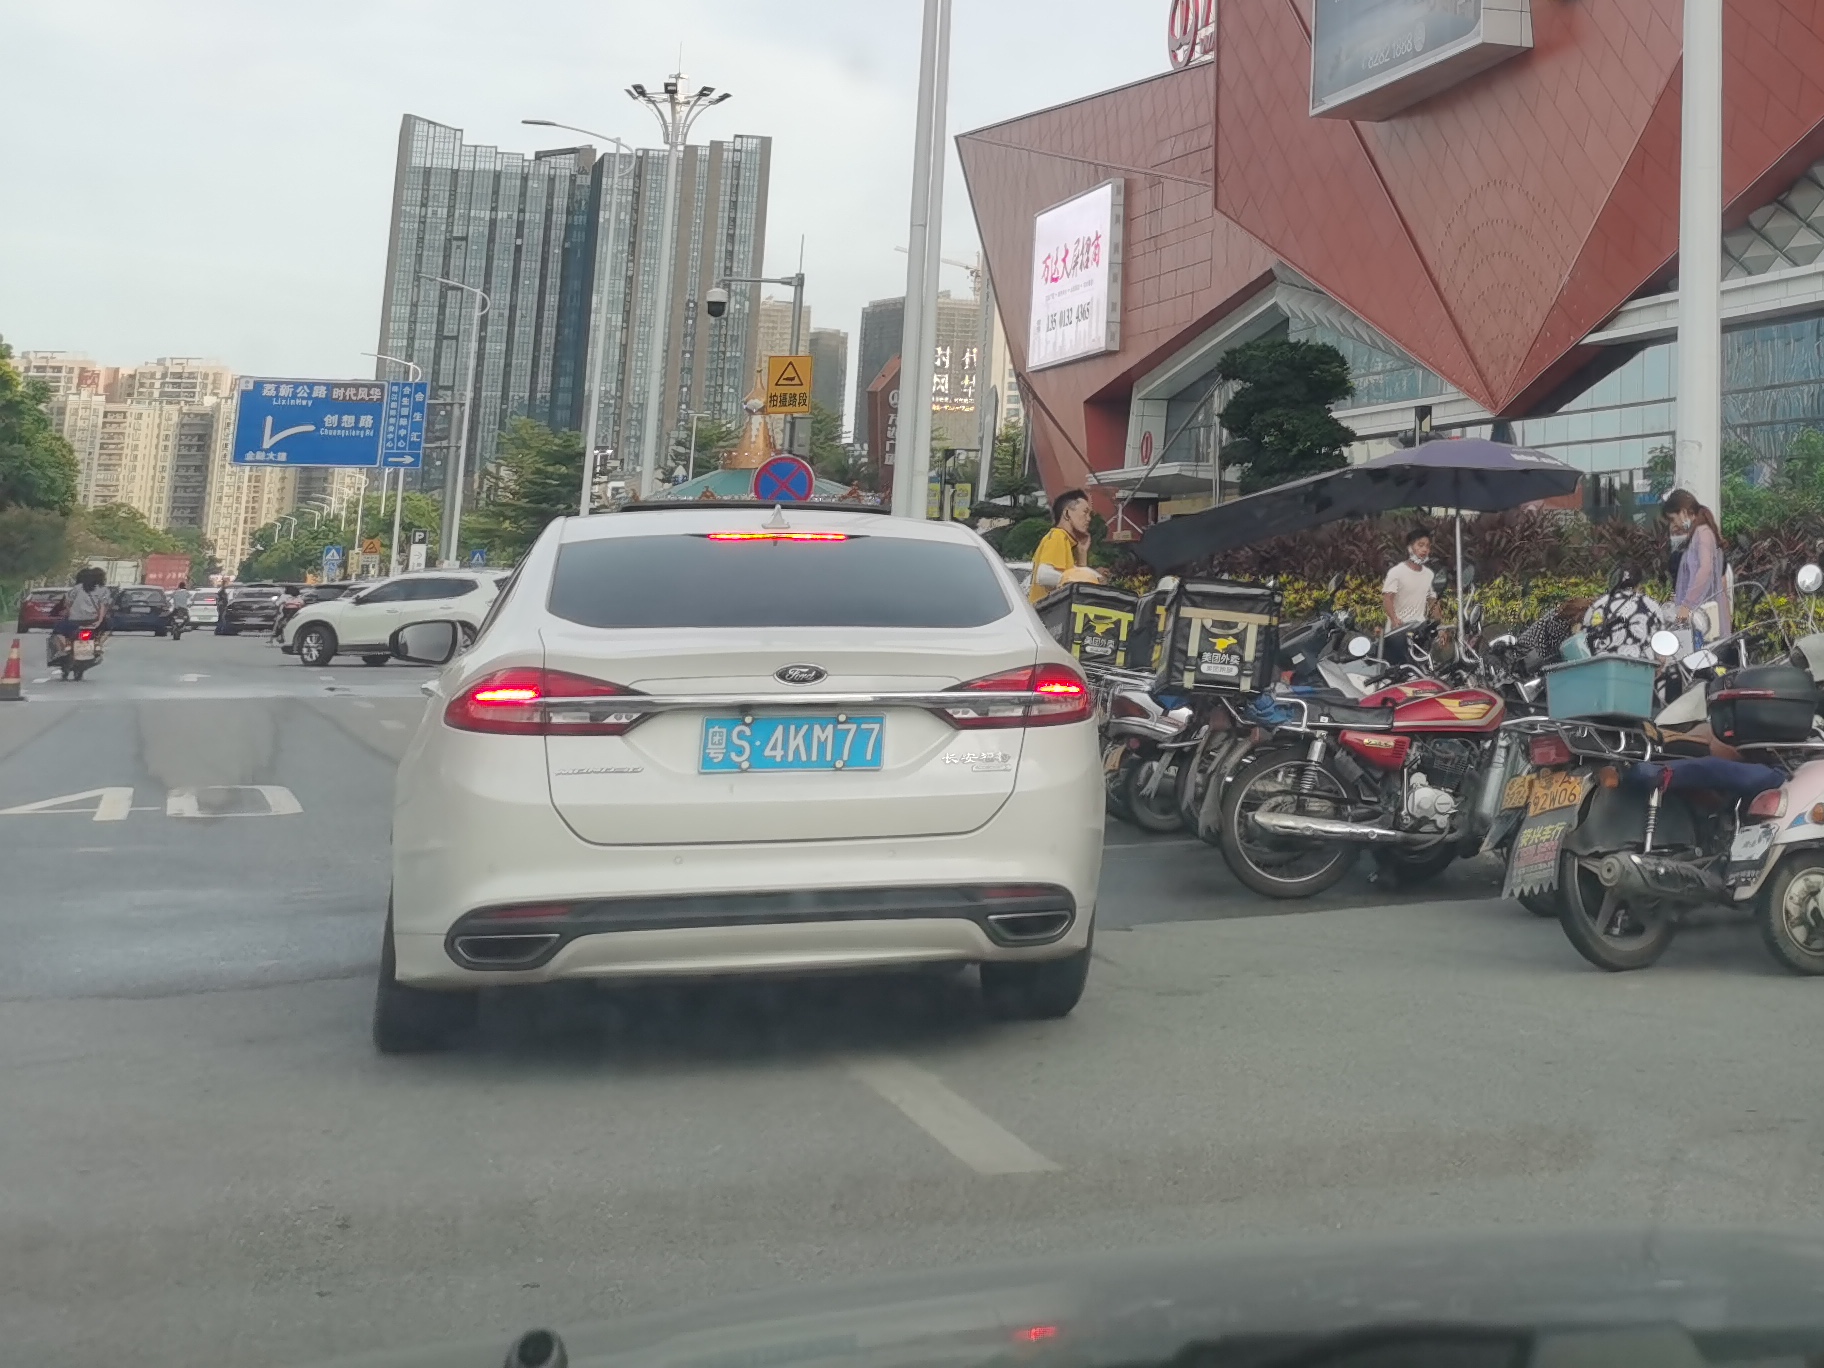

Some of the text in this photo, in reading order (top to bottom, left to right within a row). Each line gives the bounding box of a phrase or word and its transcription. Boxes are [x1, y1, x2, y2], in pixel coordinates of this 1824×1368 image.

[262, 383, 328, 399] 荔新公路
[332, 387, 382, 401] 时代风华
[768, 392, 809, 409] 拍摄路段
[323, 414, 374, 428] 创想路
[1202, 651, 1241, 666] 美团外卖
